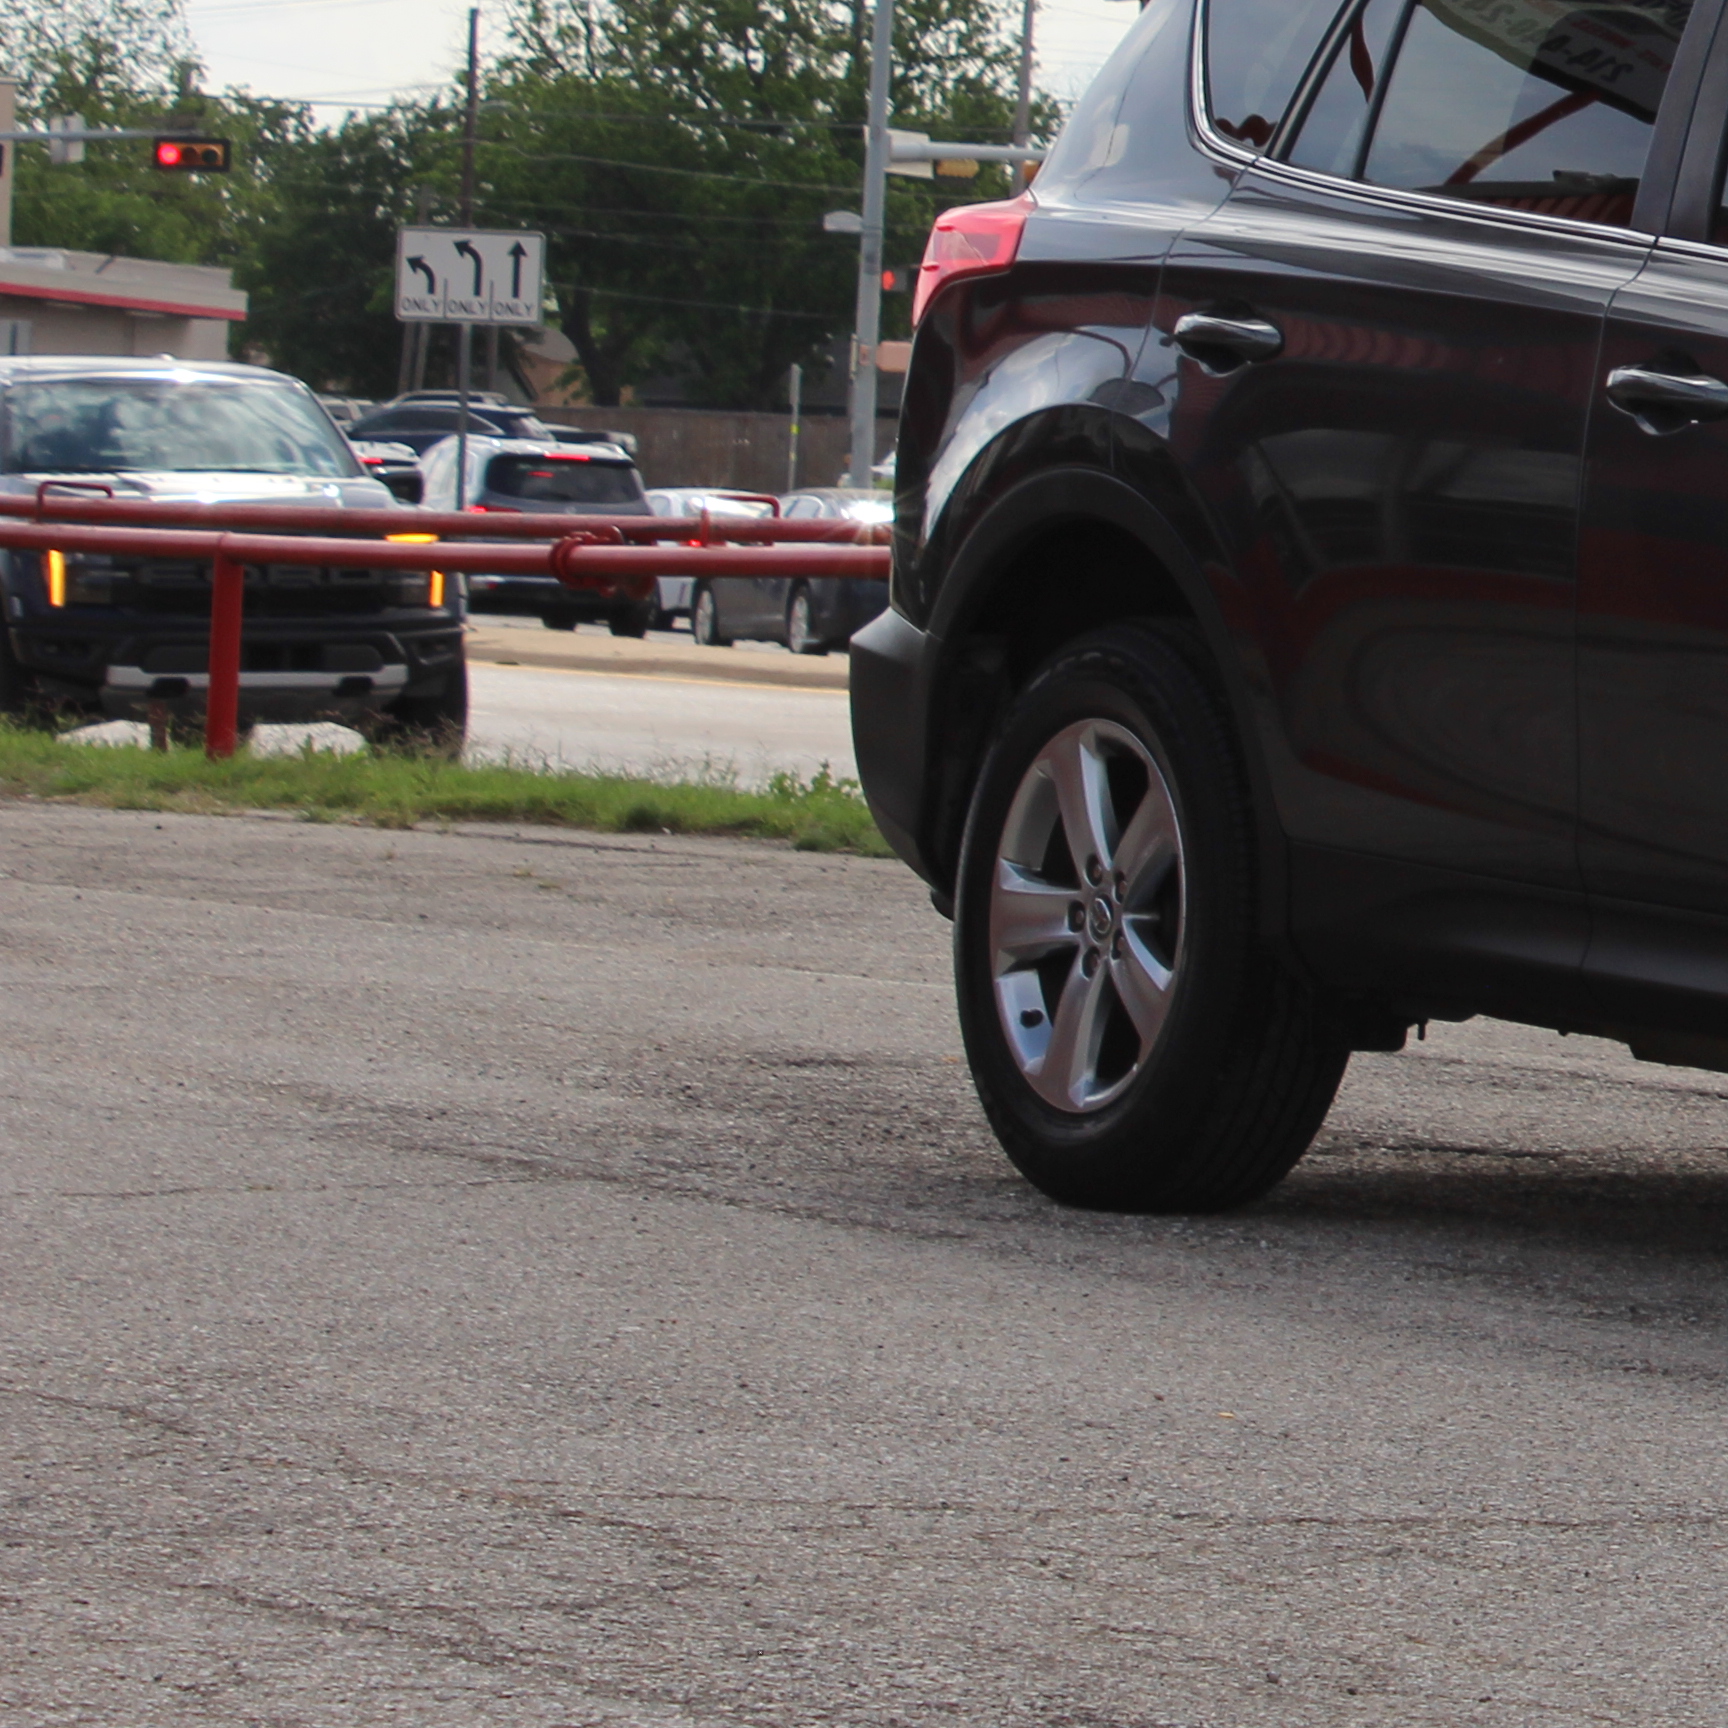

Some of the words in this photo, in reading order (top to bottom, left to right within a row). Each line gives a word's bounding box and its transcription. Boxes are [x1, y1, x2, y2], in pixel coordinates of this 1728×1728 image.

[401, 297, 441, 312] ONLY
[449, 299, 486, 315] ONLY
[494, 302, 533, 316] ONLY
